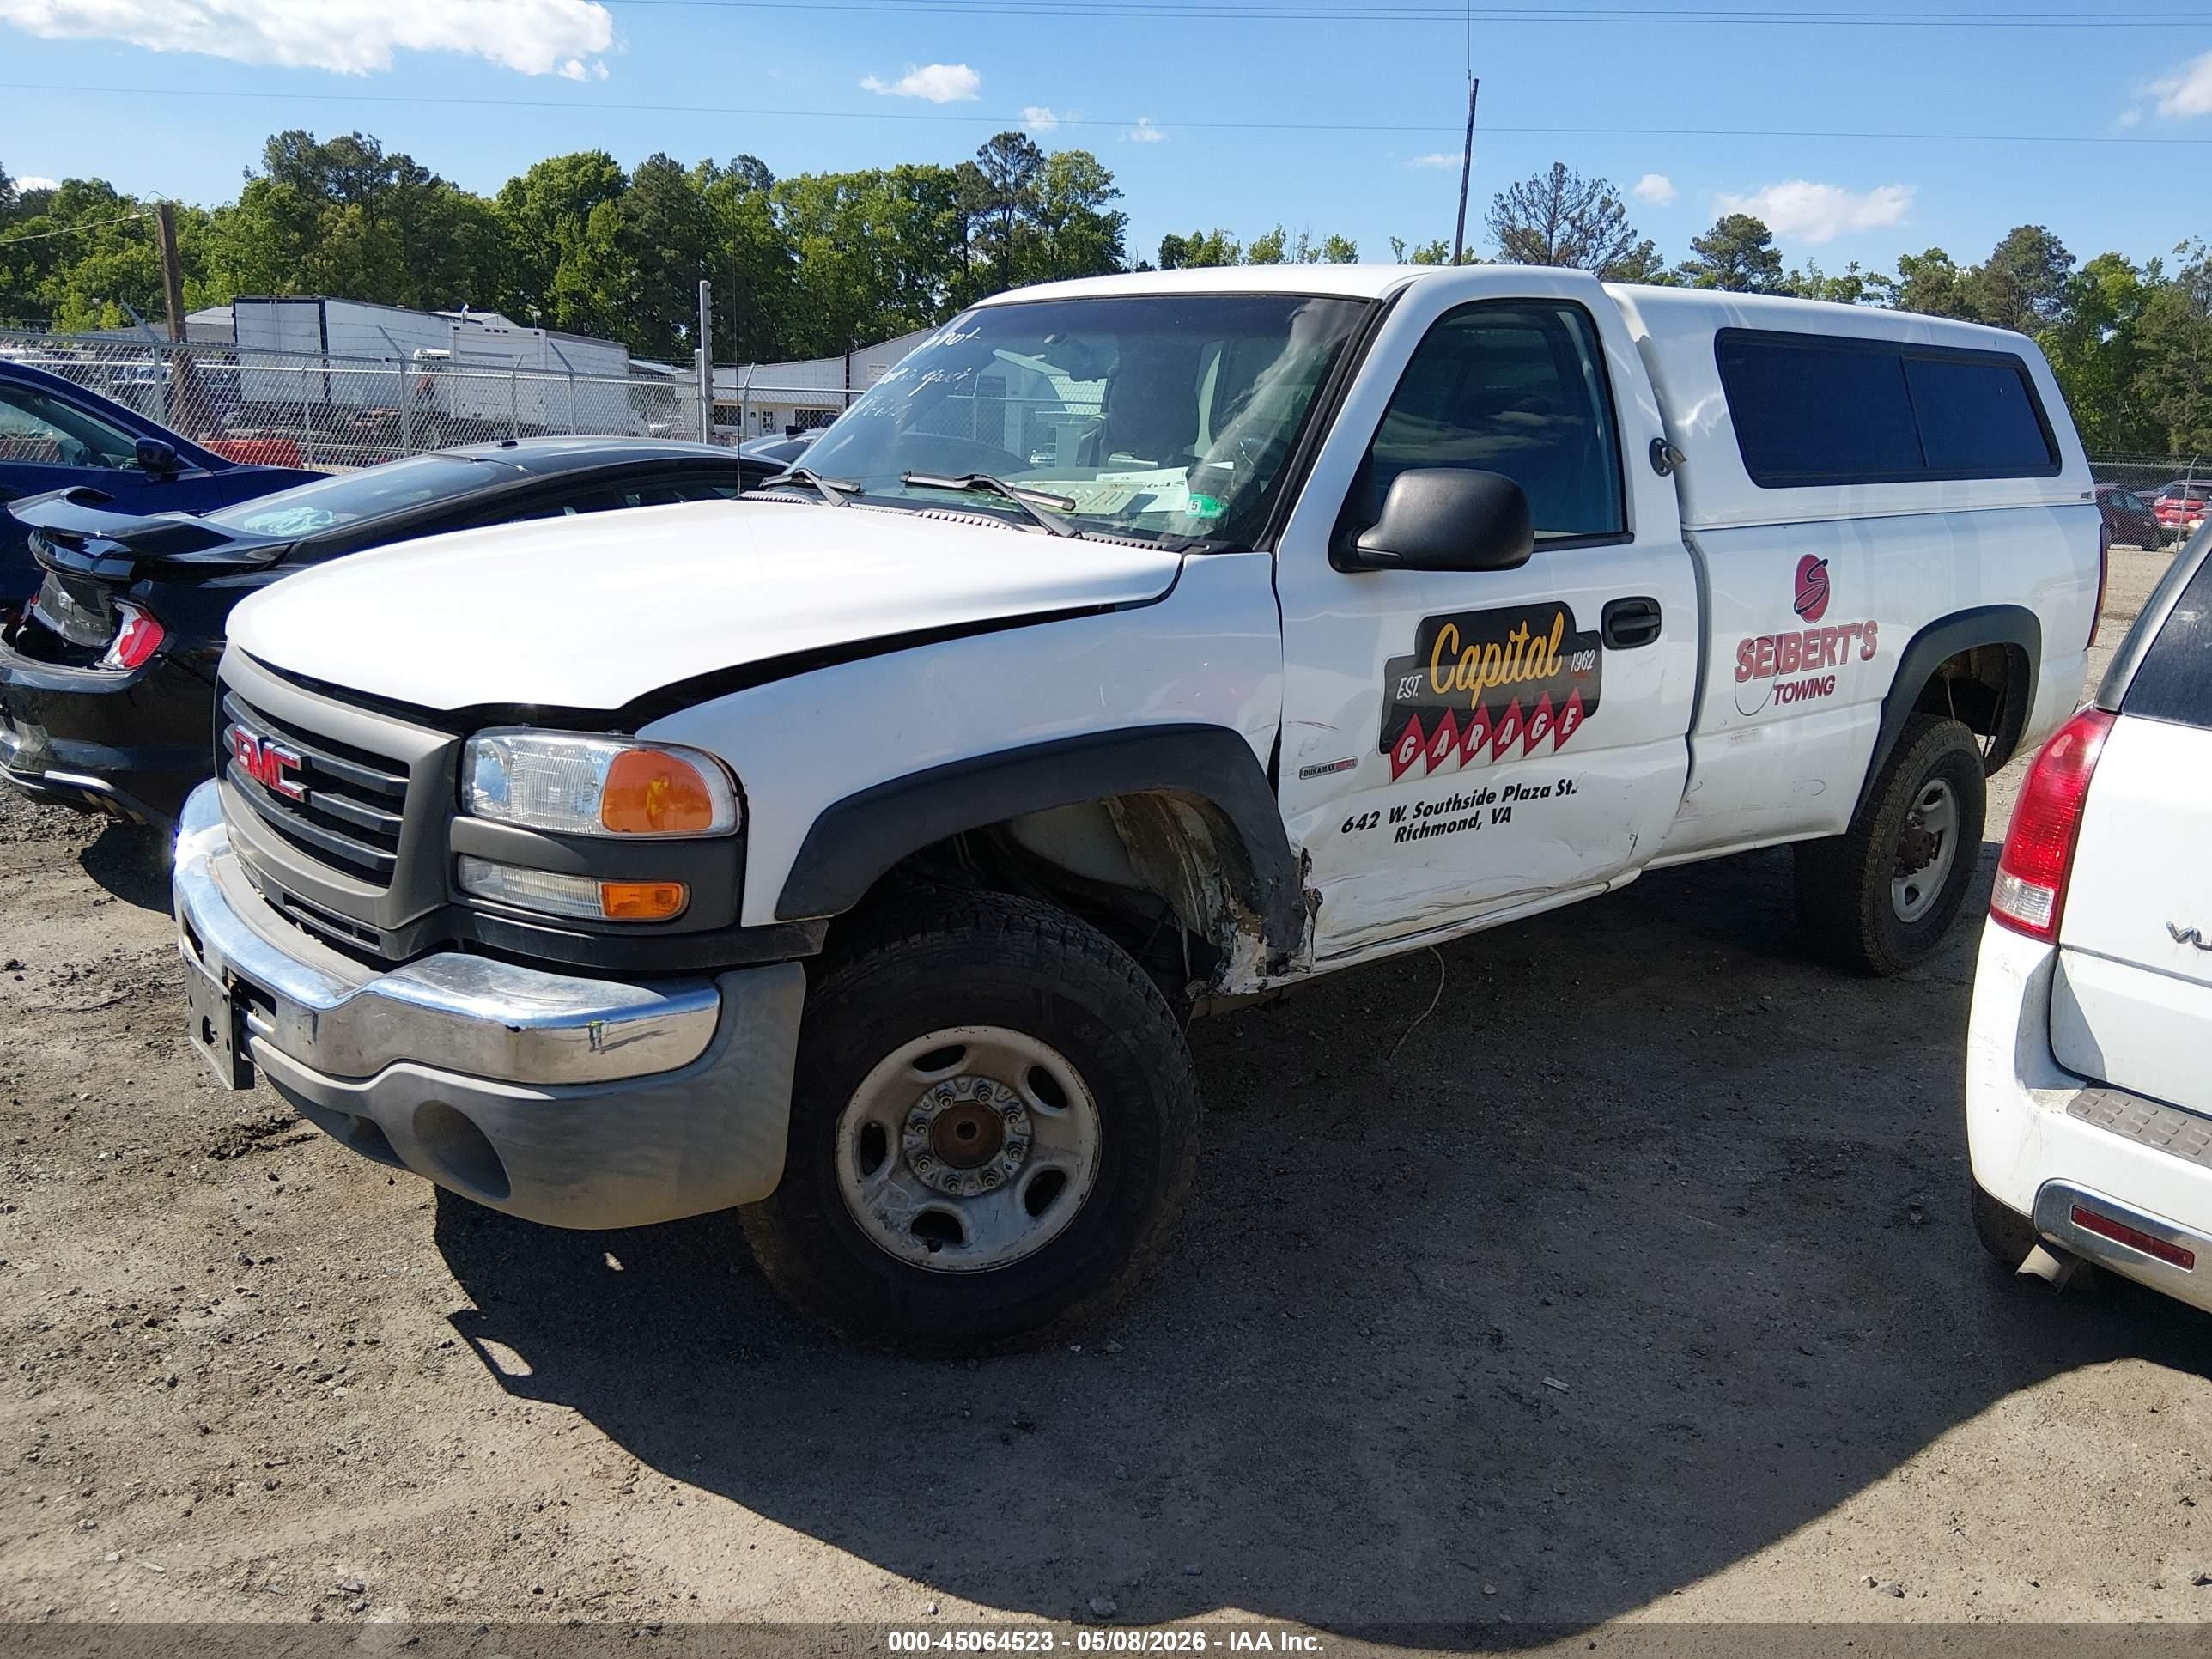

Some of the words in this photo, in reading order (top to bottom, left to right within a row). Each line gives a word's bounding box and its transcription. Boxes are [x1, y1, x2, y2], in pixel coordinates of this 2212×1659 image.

[1430, 611, 1565, 710] Capital
[1570, 649, 1595, 672] 1962
[1734, 619, 1878, 683] SEIBERT'S
[1395, 673, 1423, 701] EST.
[1772, 674, 1835, 706] TOWING
[1398, 708, 1577, 764] GARAGE
[234, 724, 305, 804] GMC
[1304, 764, 1334, 776] DURAMAX
[1340, 811, 1380, 834] 642
[1389, 804, 1407, 825] W.
[1414, 787, 1497, 819] Southside
[1501, 783, 1551, 803] Plaza
[1555, 779, 1577, 797] St.
[1393, 810, 1482, 844] Richmond,
[1491, 806, 1512, 825] VA
